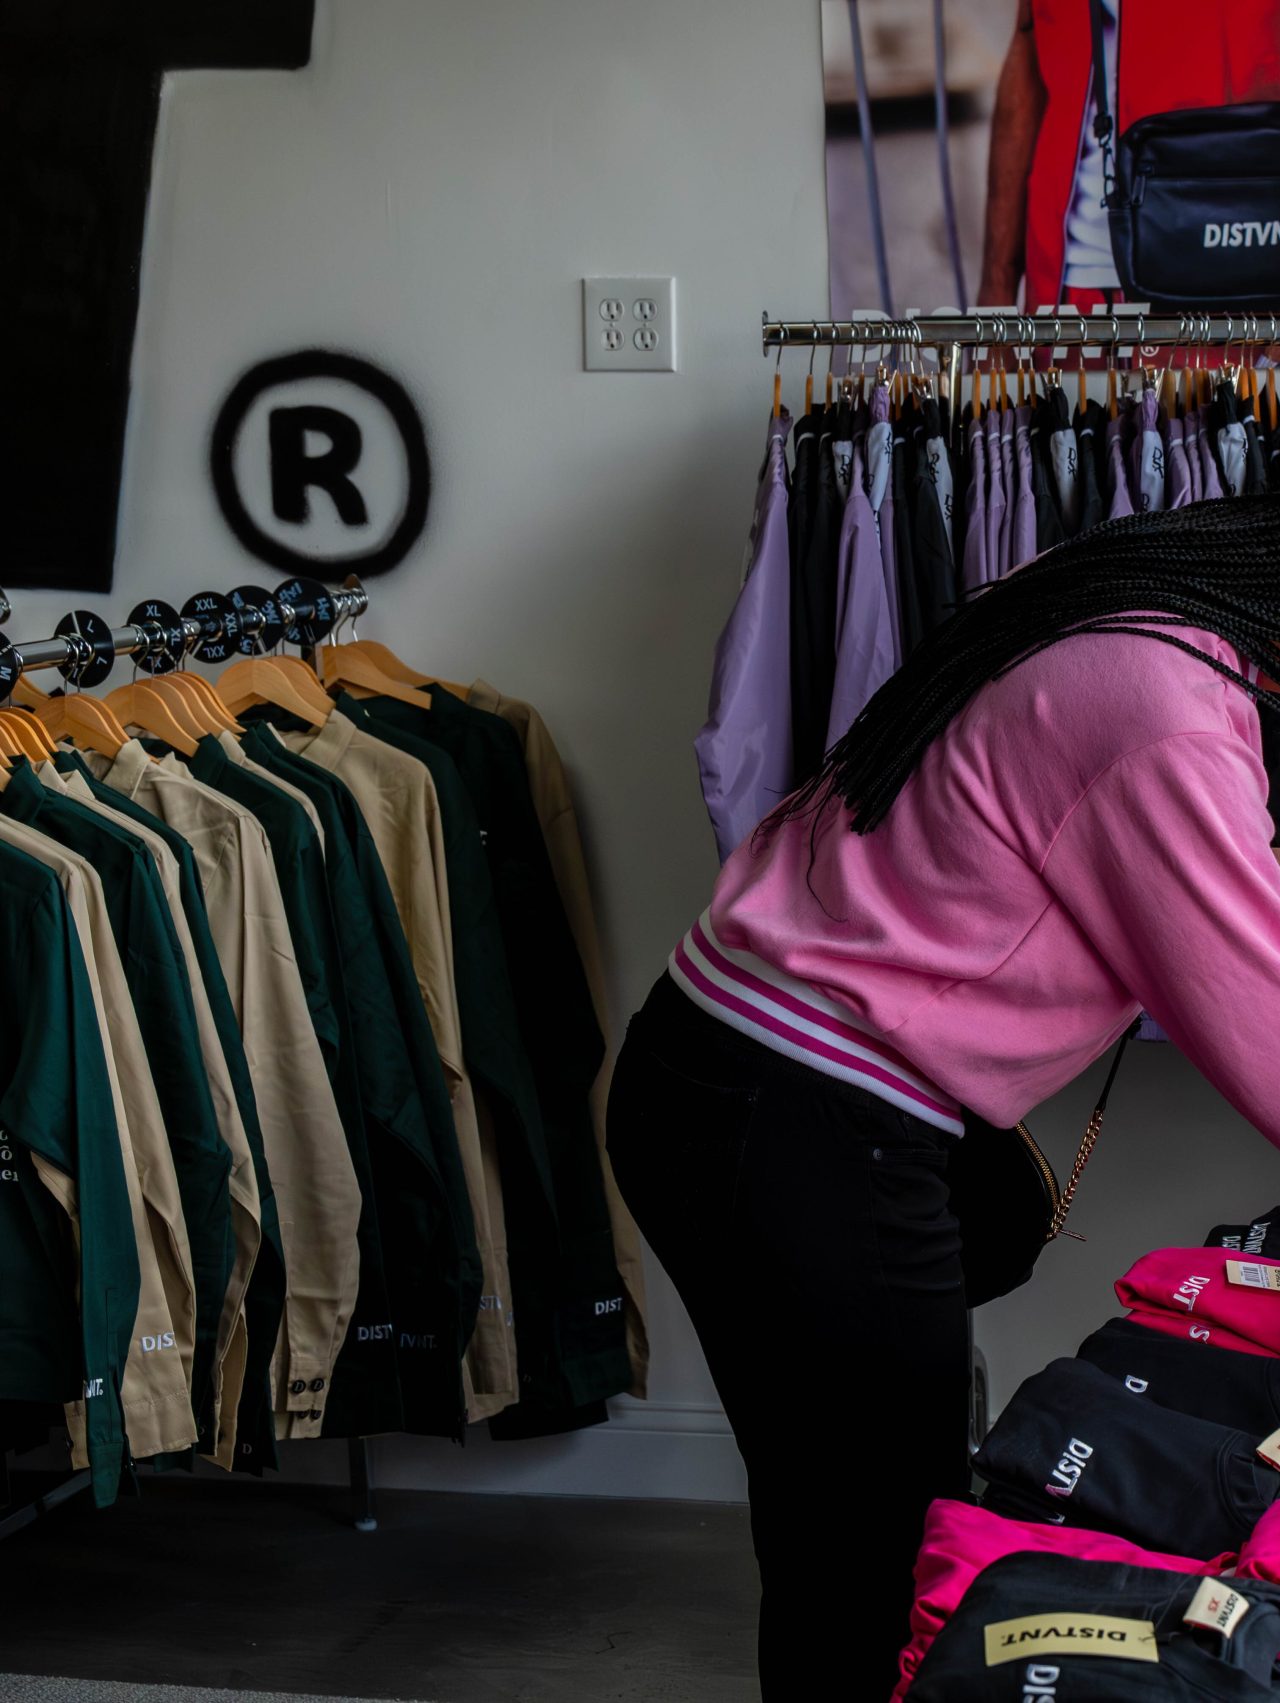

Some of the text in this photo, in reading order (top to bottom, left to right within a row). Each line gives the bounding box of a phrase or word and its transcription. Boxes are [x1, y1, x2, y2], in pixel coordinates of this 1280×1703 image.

[146, 605, 161, 617] XL
[195, 599, 218, 611] XXL
[86, 619, 95, 633] L
[224, 613, 238, 638] XXL
[170, 628, 181, 646] XL
[1173, 1275, 1210, 1311] DIST
[594, 1297, 623, 1315] DIST
